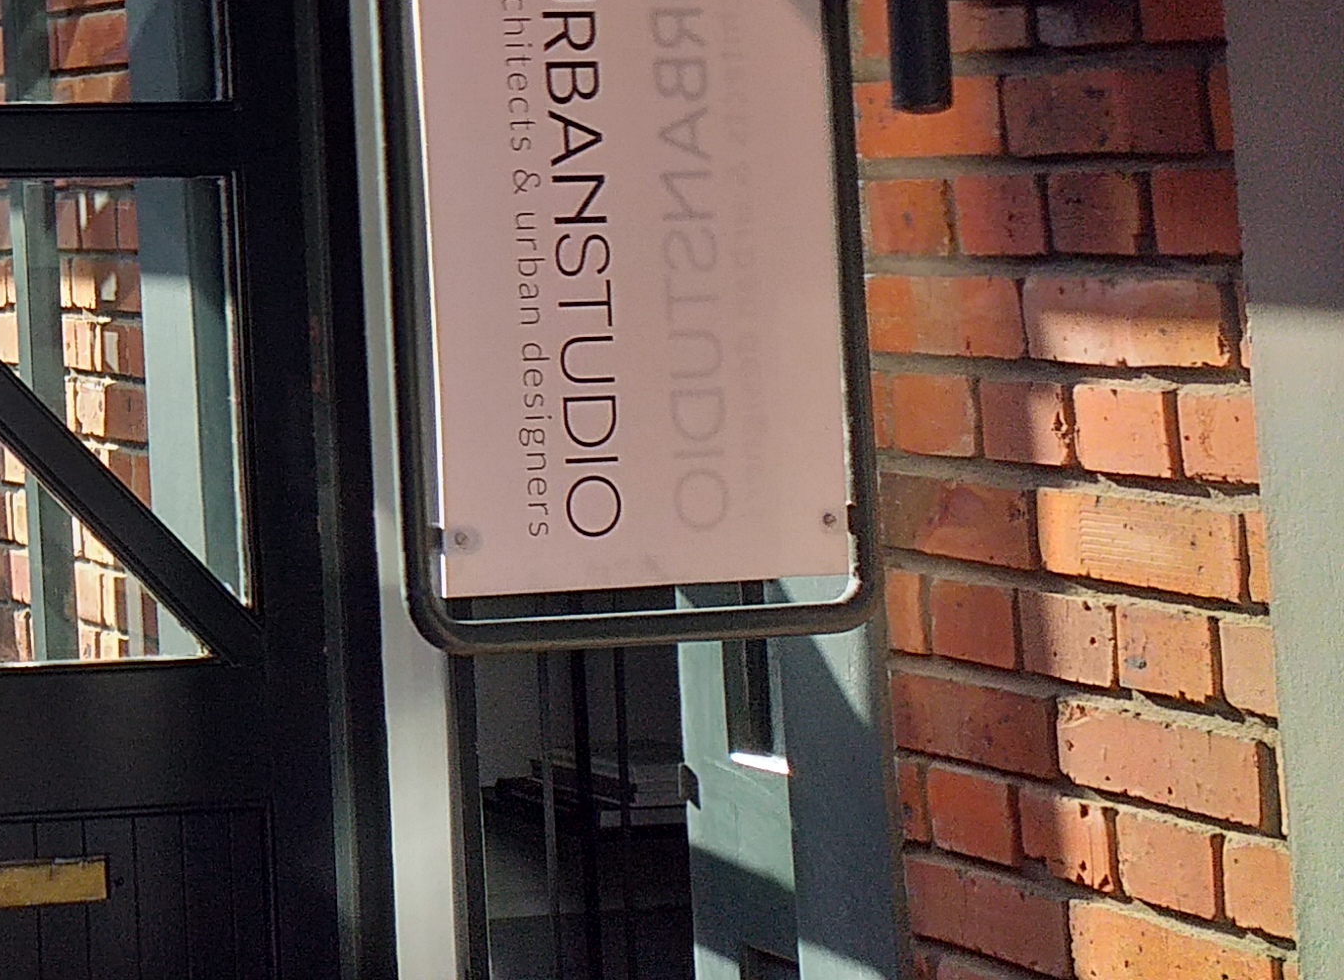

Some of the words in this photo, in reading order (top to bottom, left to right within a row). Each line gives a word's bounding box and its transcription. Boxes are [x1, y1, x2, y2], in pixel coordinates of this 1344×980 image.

[513, 169, 541, 195] &
[515, 211, 546, 330] urban
[518, 341, 549, 539] designers
